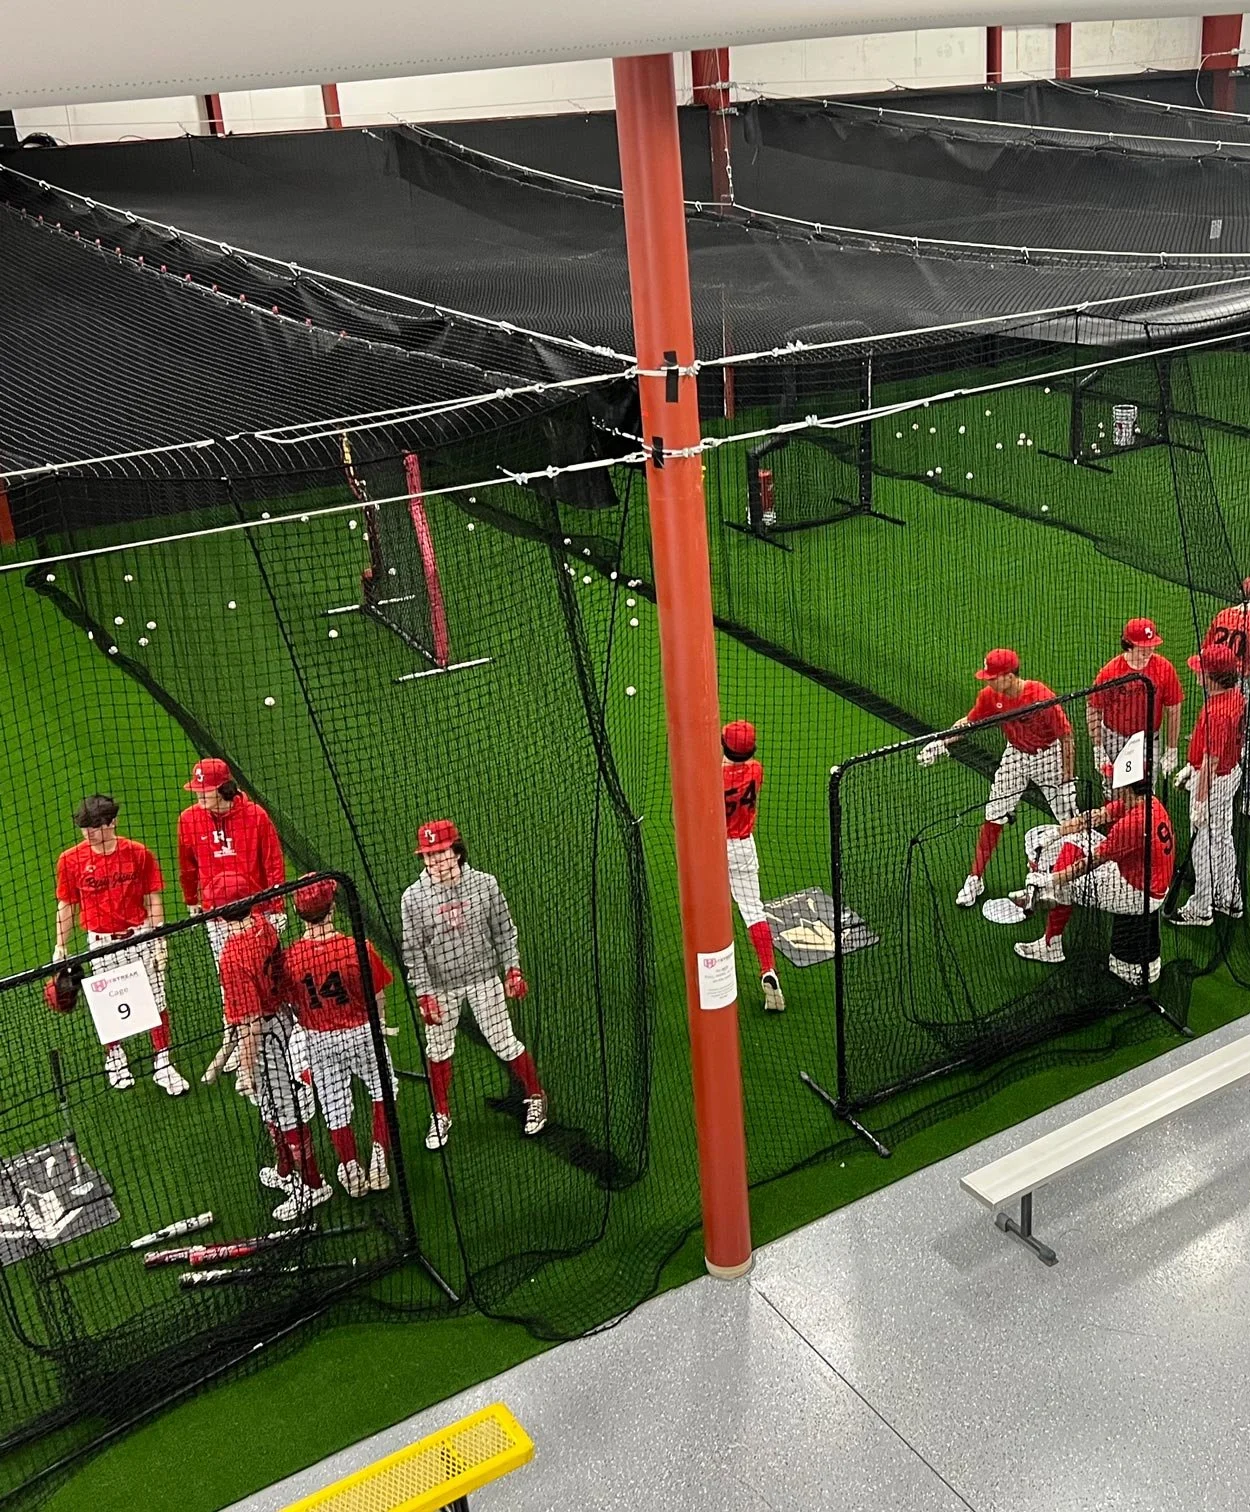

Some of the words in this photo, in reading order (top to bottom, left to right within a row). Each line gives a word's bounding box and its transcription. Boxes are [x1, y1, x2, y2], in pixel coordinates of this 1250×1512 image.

[1125, 760, 1132, 773] 8
[724, 779, 757, 816] 54
[1157, 822, 1173, 855] 9
[108, 987, 129, 998] Cage
[302, 970, 350, 1009] 14
[117, 1003, 131, 1020] 9
